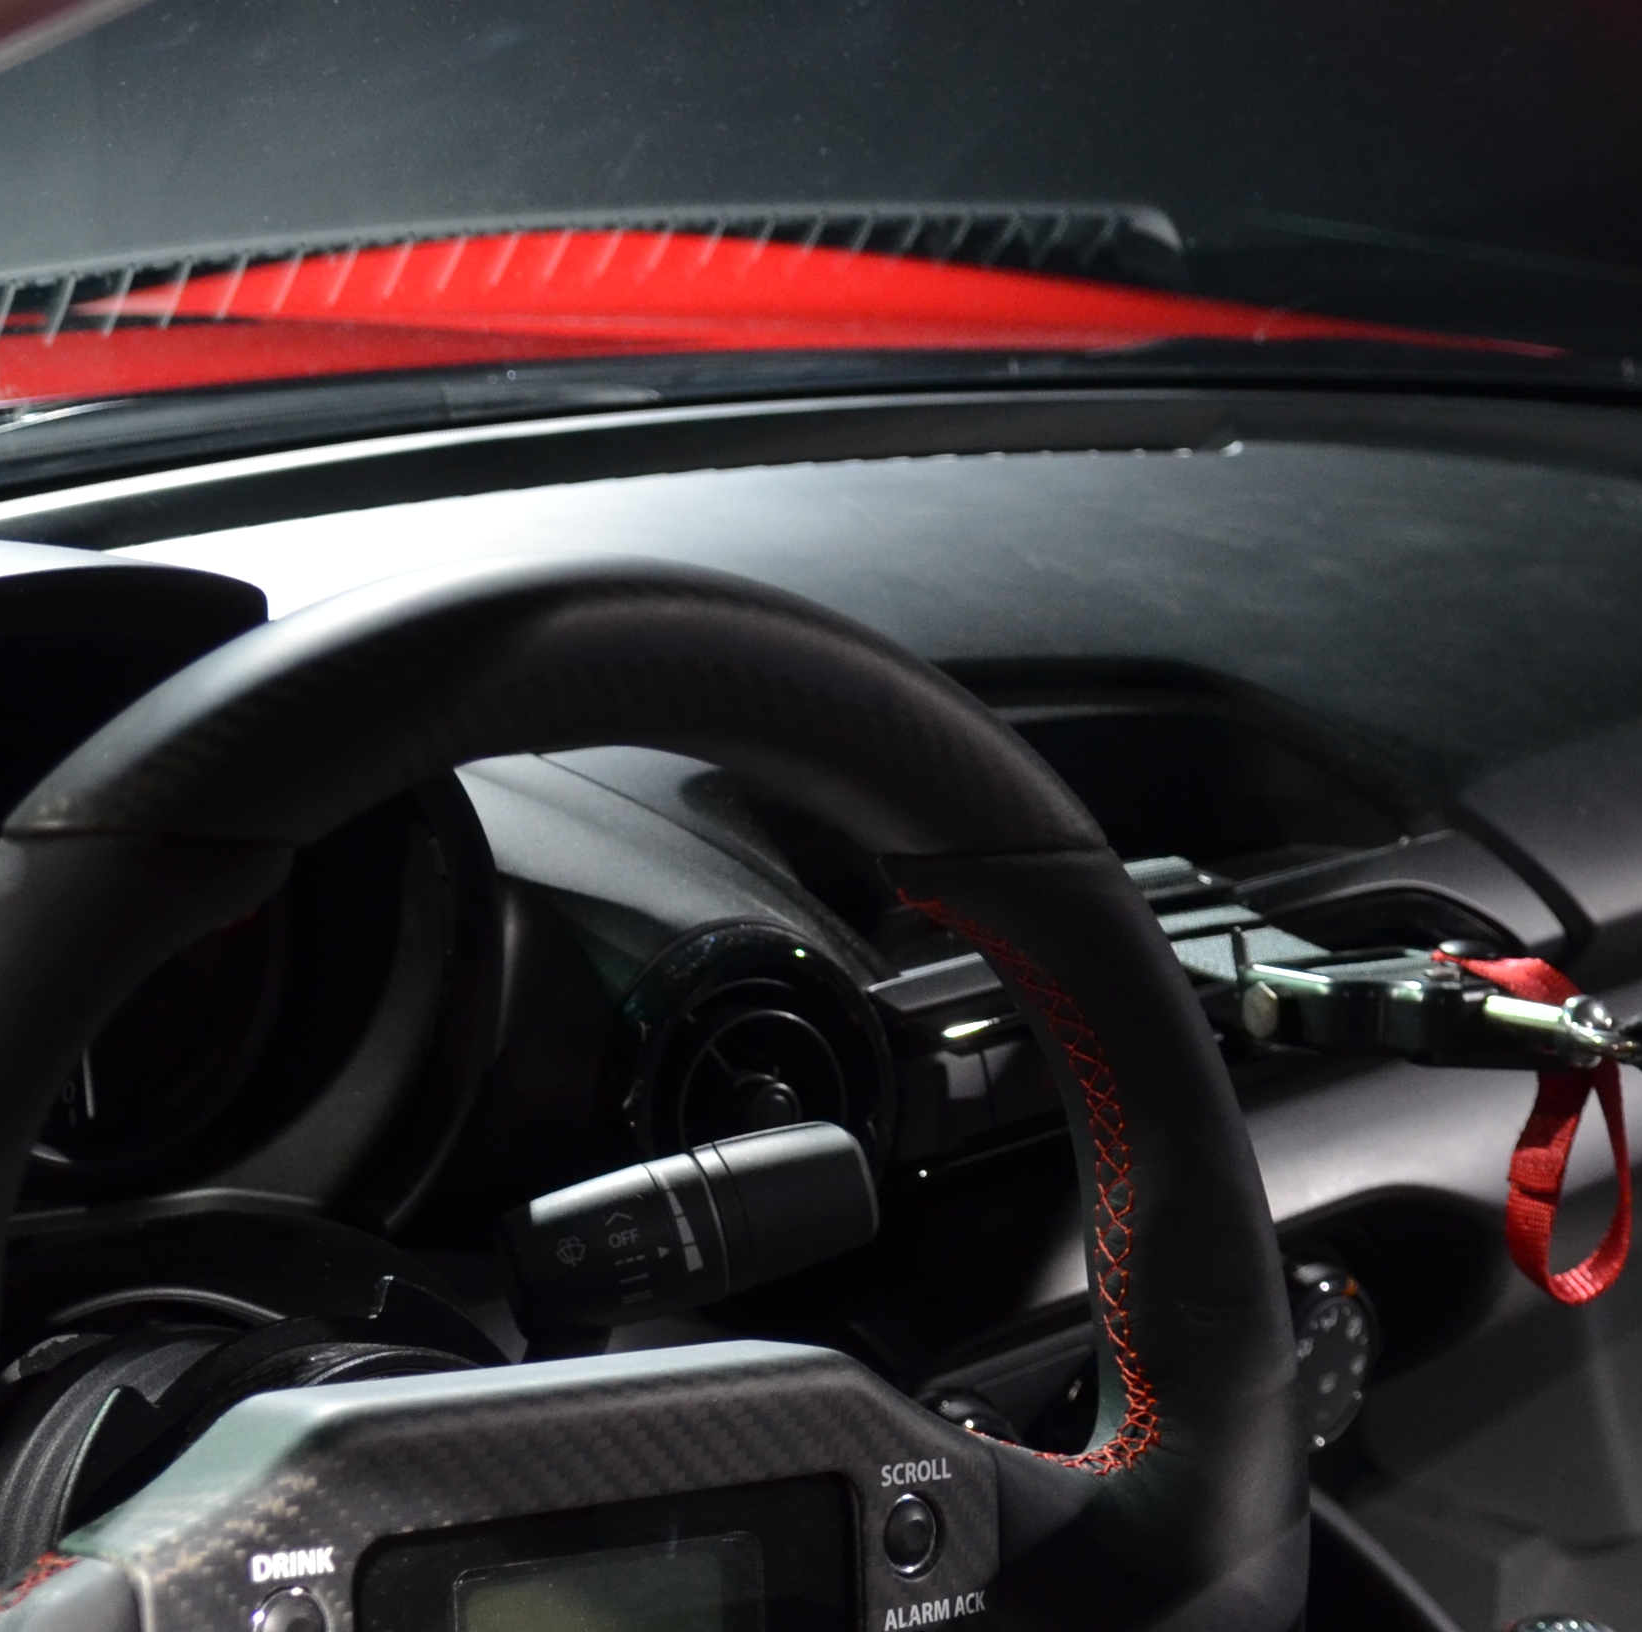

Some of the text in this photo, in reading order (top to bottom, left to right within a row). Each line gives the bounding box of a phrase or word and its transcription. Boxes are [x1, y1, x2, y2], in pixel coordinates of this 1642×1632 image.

[608, 1228, 639, 1249] OFF
[880, 1457, 952, 1488] SCROLL
[251, 1547, 335, 1583] DRINK
[883, 1590, 986, 1632] ALARM ACK
